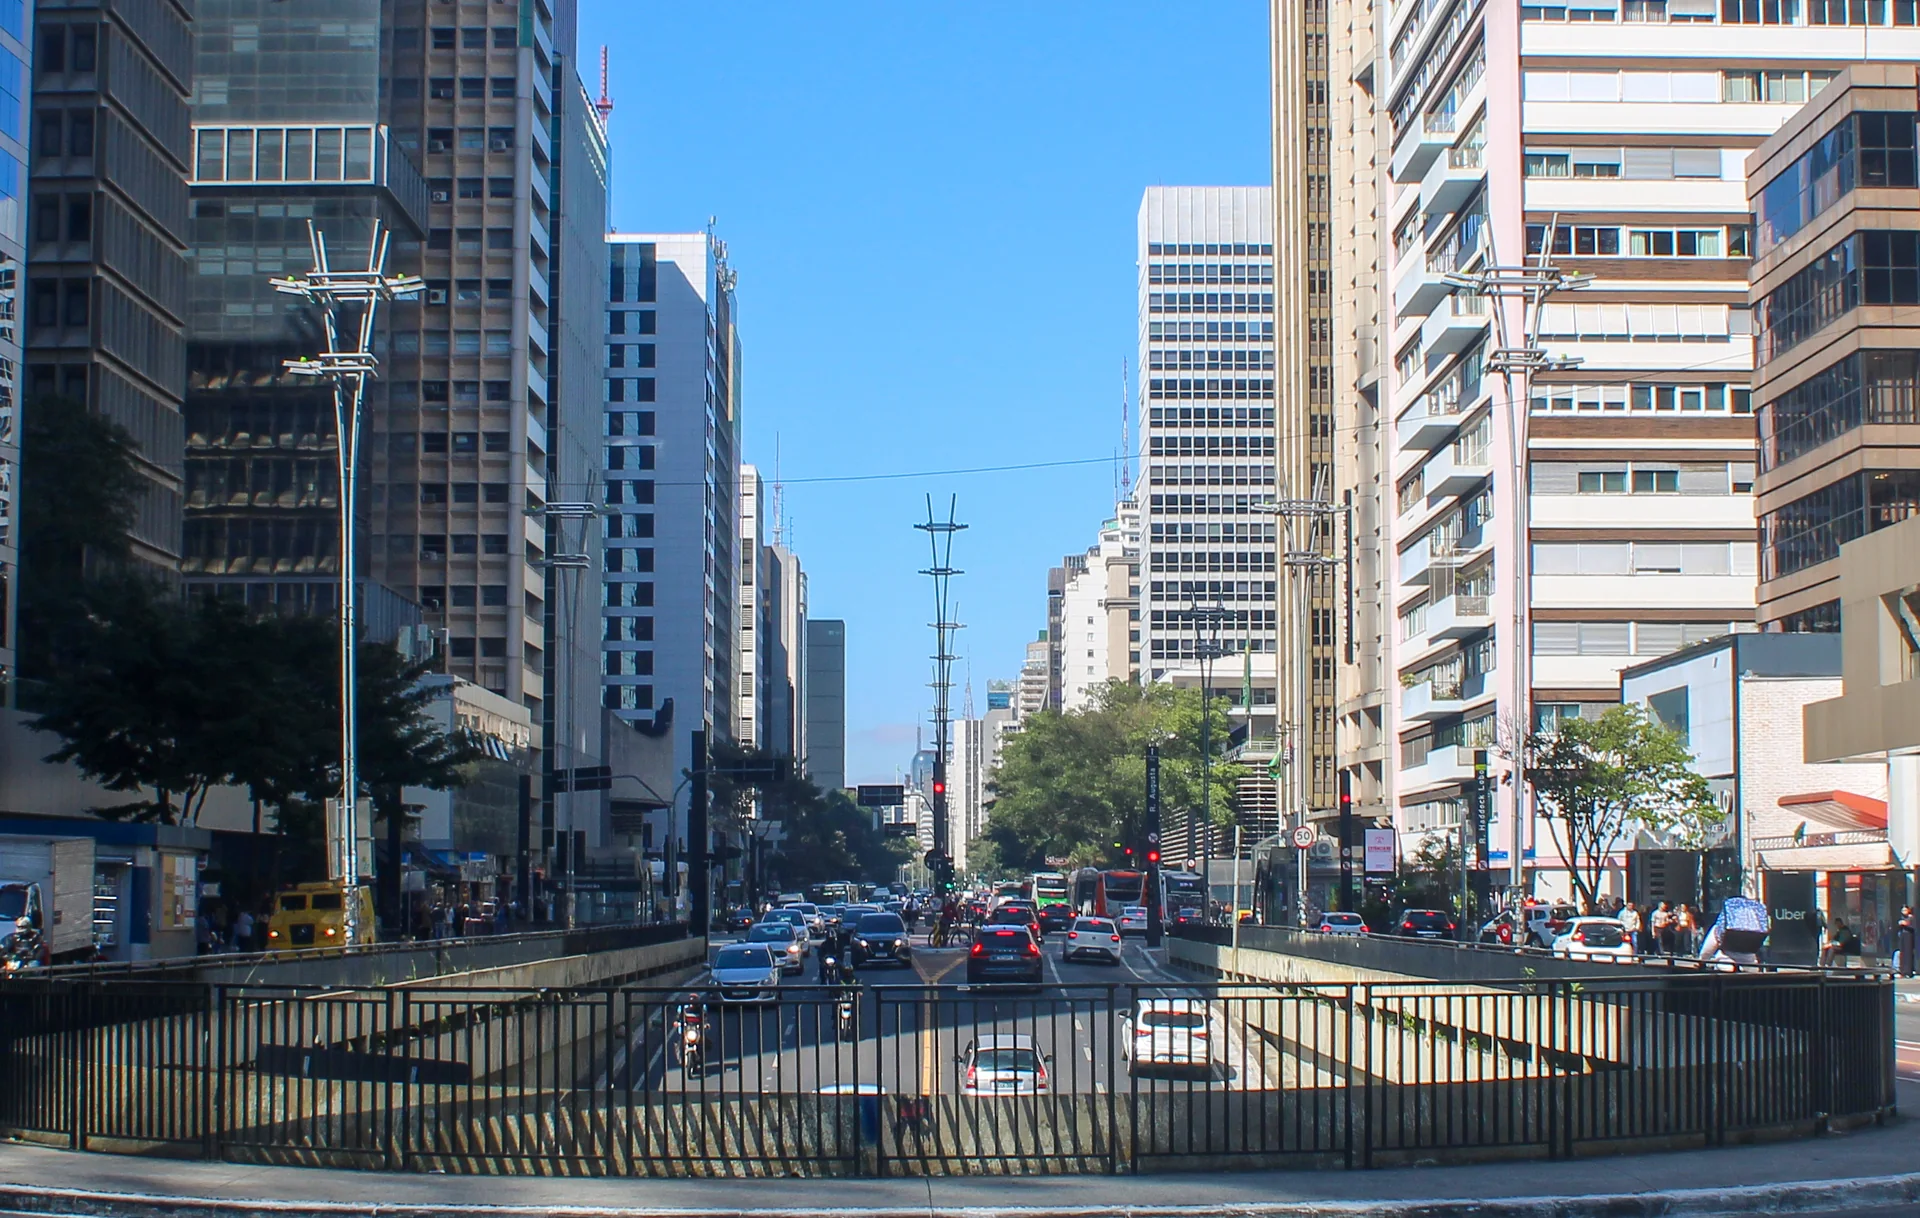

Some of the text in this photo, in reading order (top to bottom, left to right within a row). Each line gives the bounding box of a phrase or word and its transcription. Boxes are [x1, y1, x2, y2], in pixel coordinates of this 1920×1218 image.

[1149, 767, 1157, 813] R. Augusta
[1478, 770, 1486, 844] R. Haddock Lobo
[1297, 831, 1310, 840] 50
[1775, 908, 1805, 920] Uber
